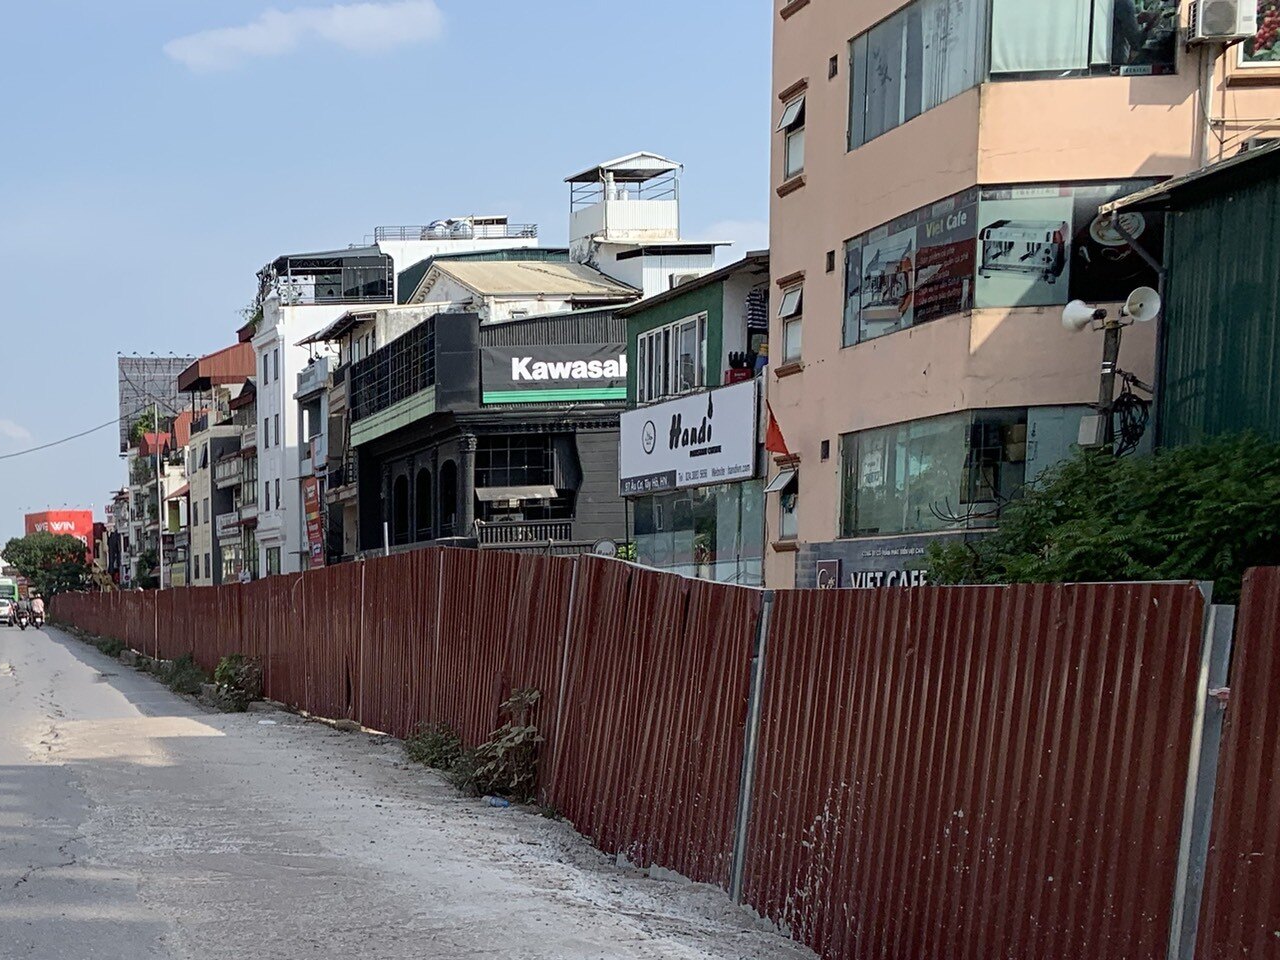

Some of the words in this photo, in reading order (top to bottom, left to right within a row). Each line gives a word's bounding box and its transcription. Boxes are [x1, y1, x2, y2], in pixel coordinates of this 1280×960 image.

[925, 219, 944, 238] Viet
[946, 211, 967, 231] Cafe
[669, 391, 714, 450] Handi
[34, 522, 48, 531] WE
[50, 521, 75, 531] WIN
[850, 572, 884, 589] VIET
